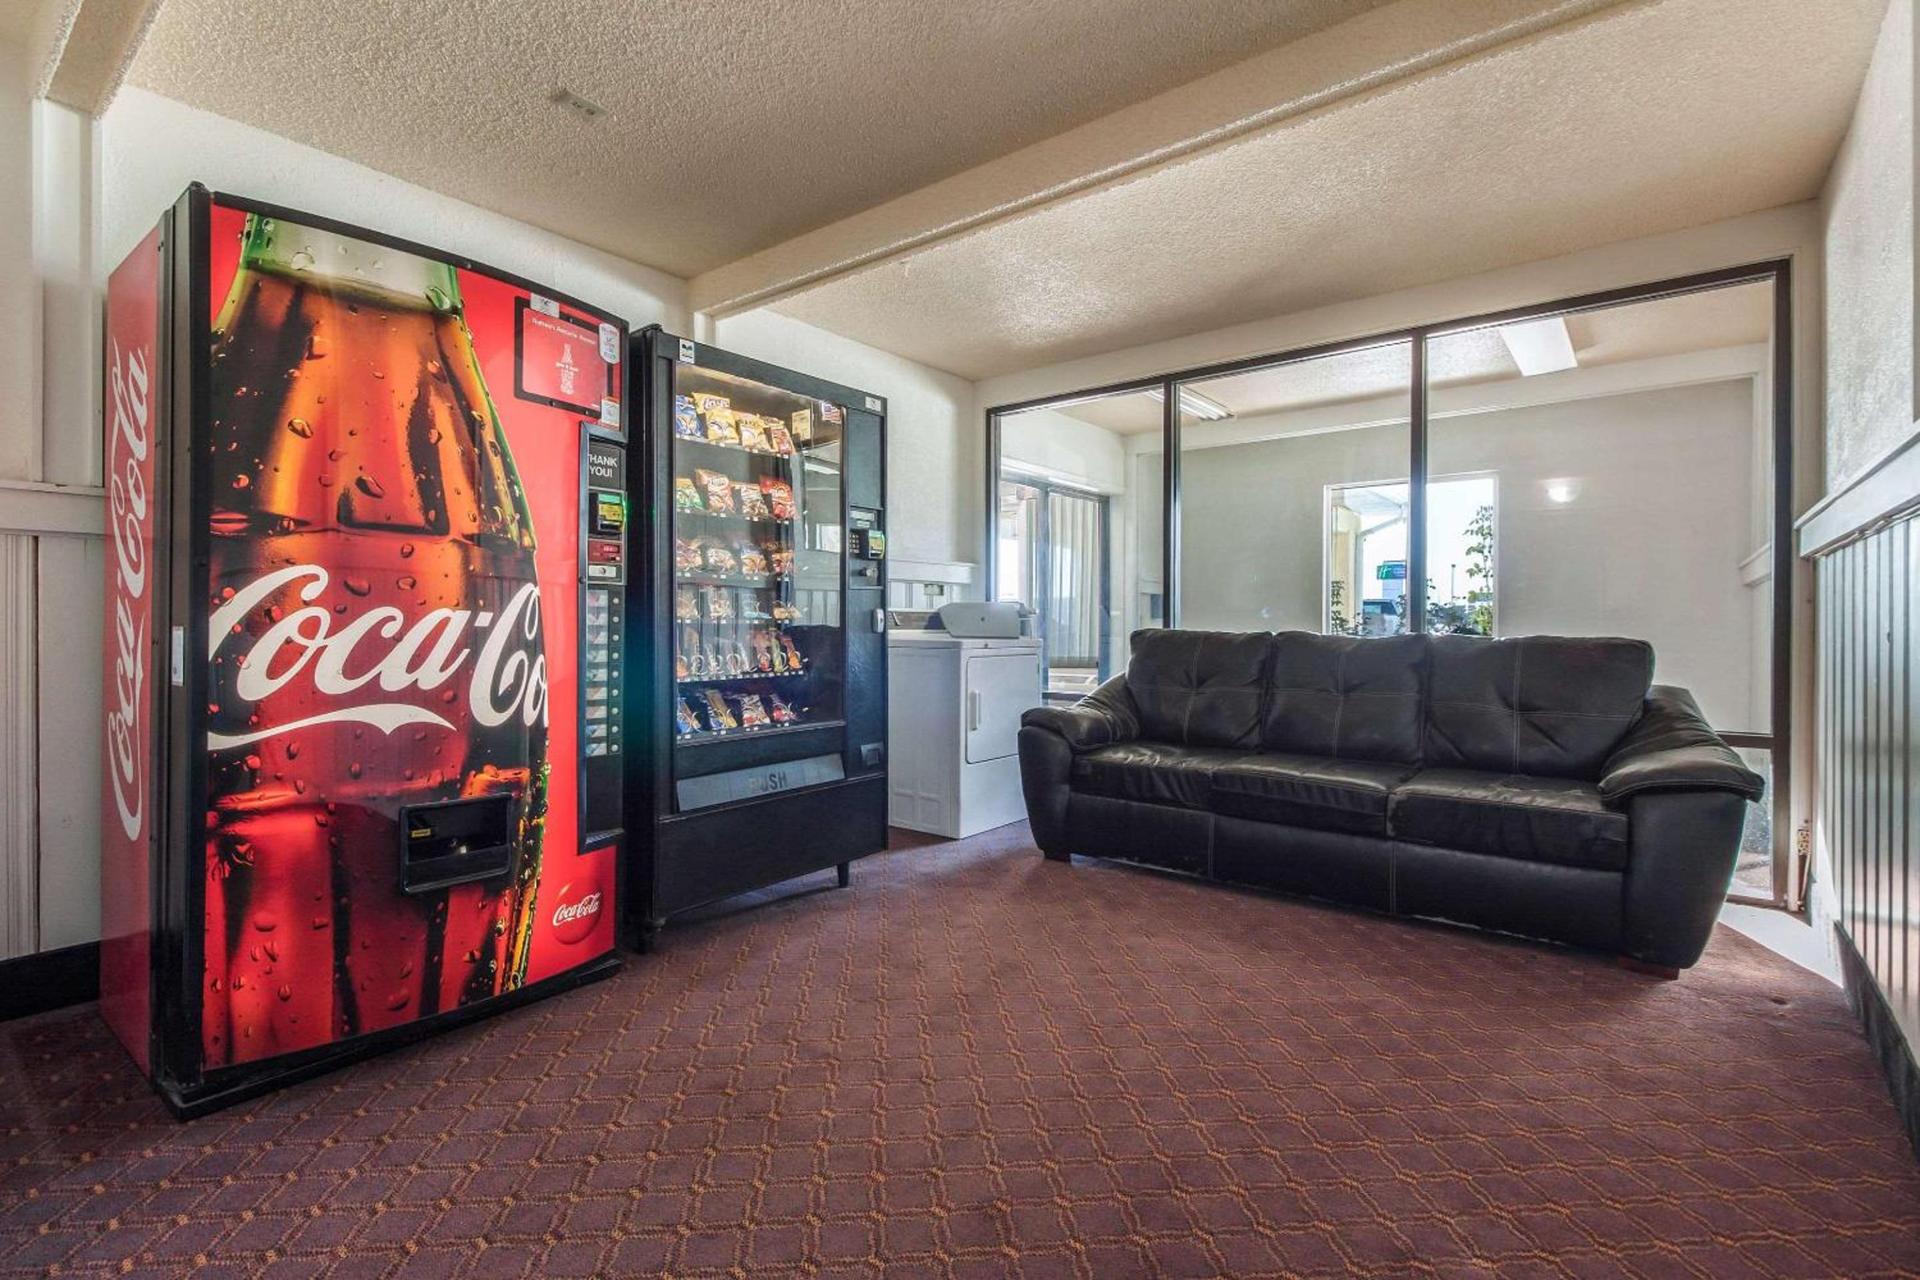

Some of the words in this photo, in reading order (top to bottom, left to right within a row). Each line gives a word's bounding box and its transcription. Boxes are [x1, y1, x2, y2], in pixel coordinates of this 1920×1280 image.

[106, 337, 151, 843] Coca-Cola
[752, 770, 788, 793] USH
[552, 891, 602, 927] Coca-Cola
